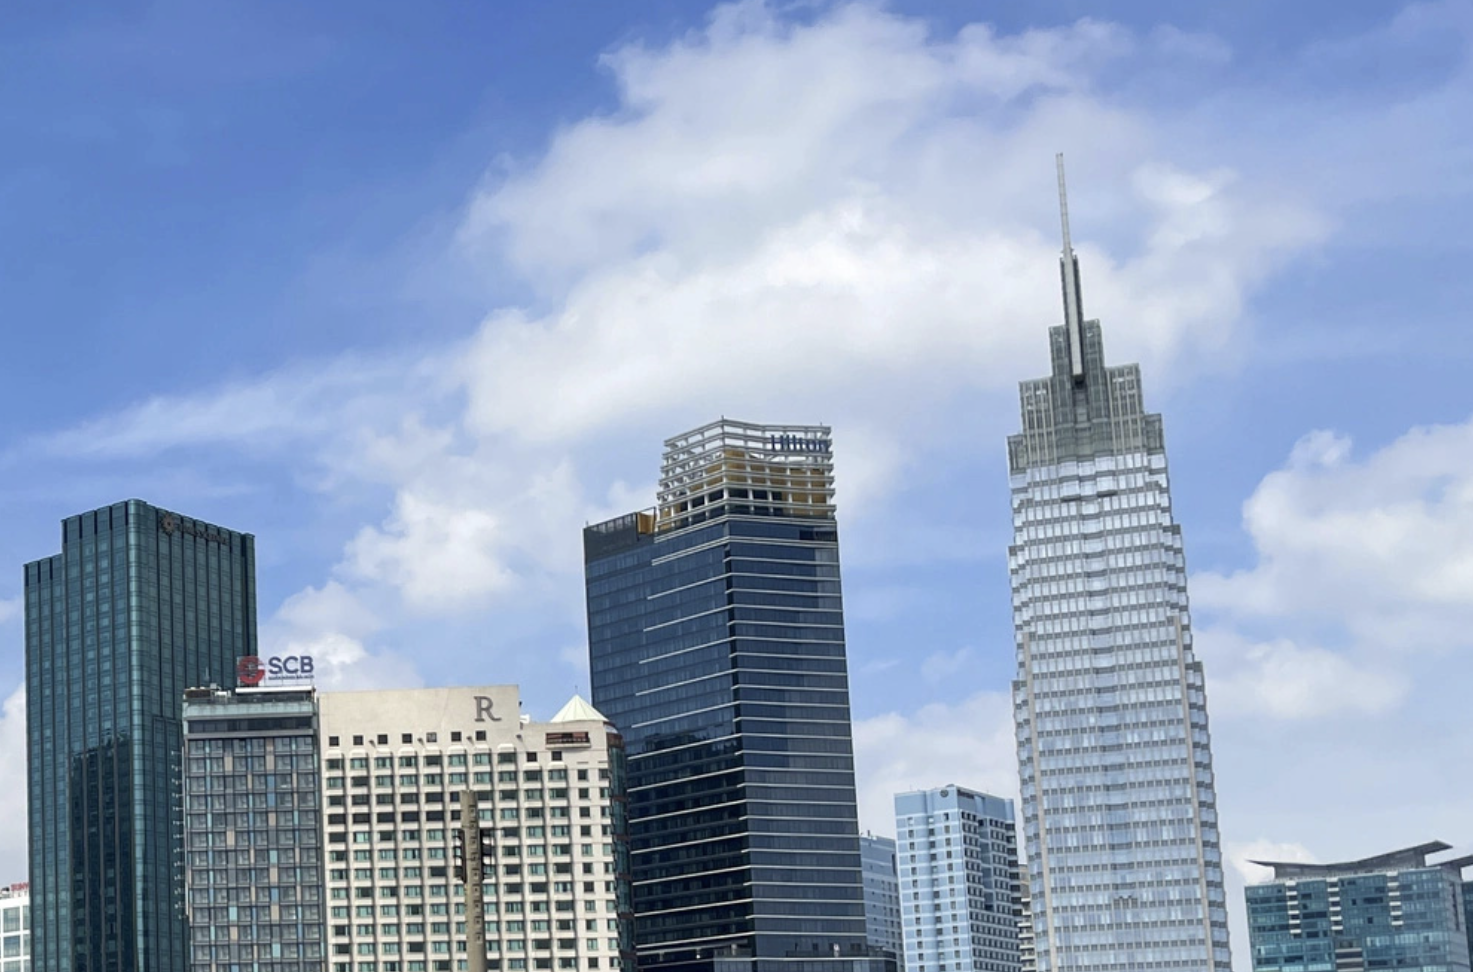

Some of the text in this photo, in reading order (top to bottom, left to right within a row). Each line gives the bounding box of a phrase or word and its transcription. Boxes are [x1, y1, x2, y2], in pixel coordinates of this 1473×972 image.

[771, 434, 829, 453] Hilton
[268, 655, 314, 674] SCB
[473, 695, 502, 722] R
